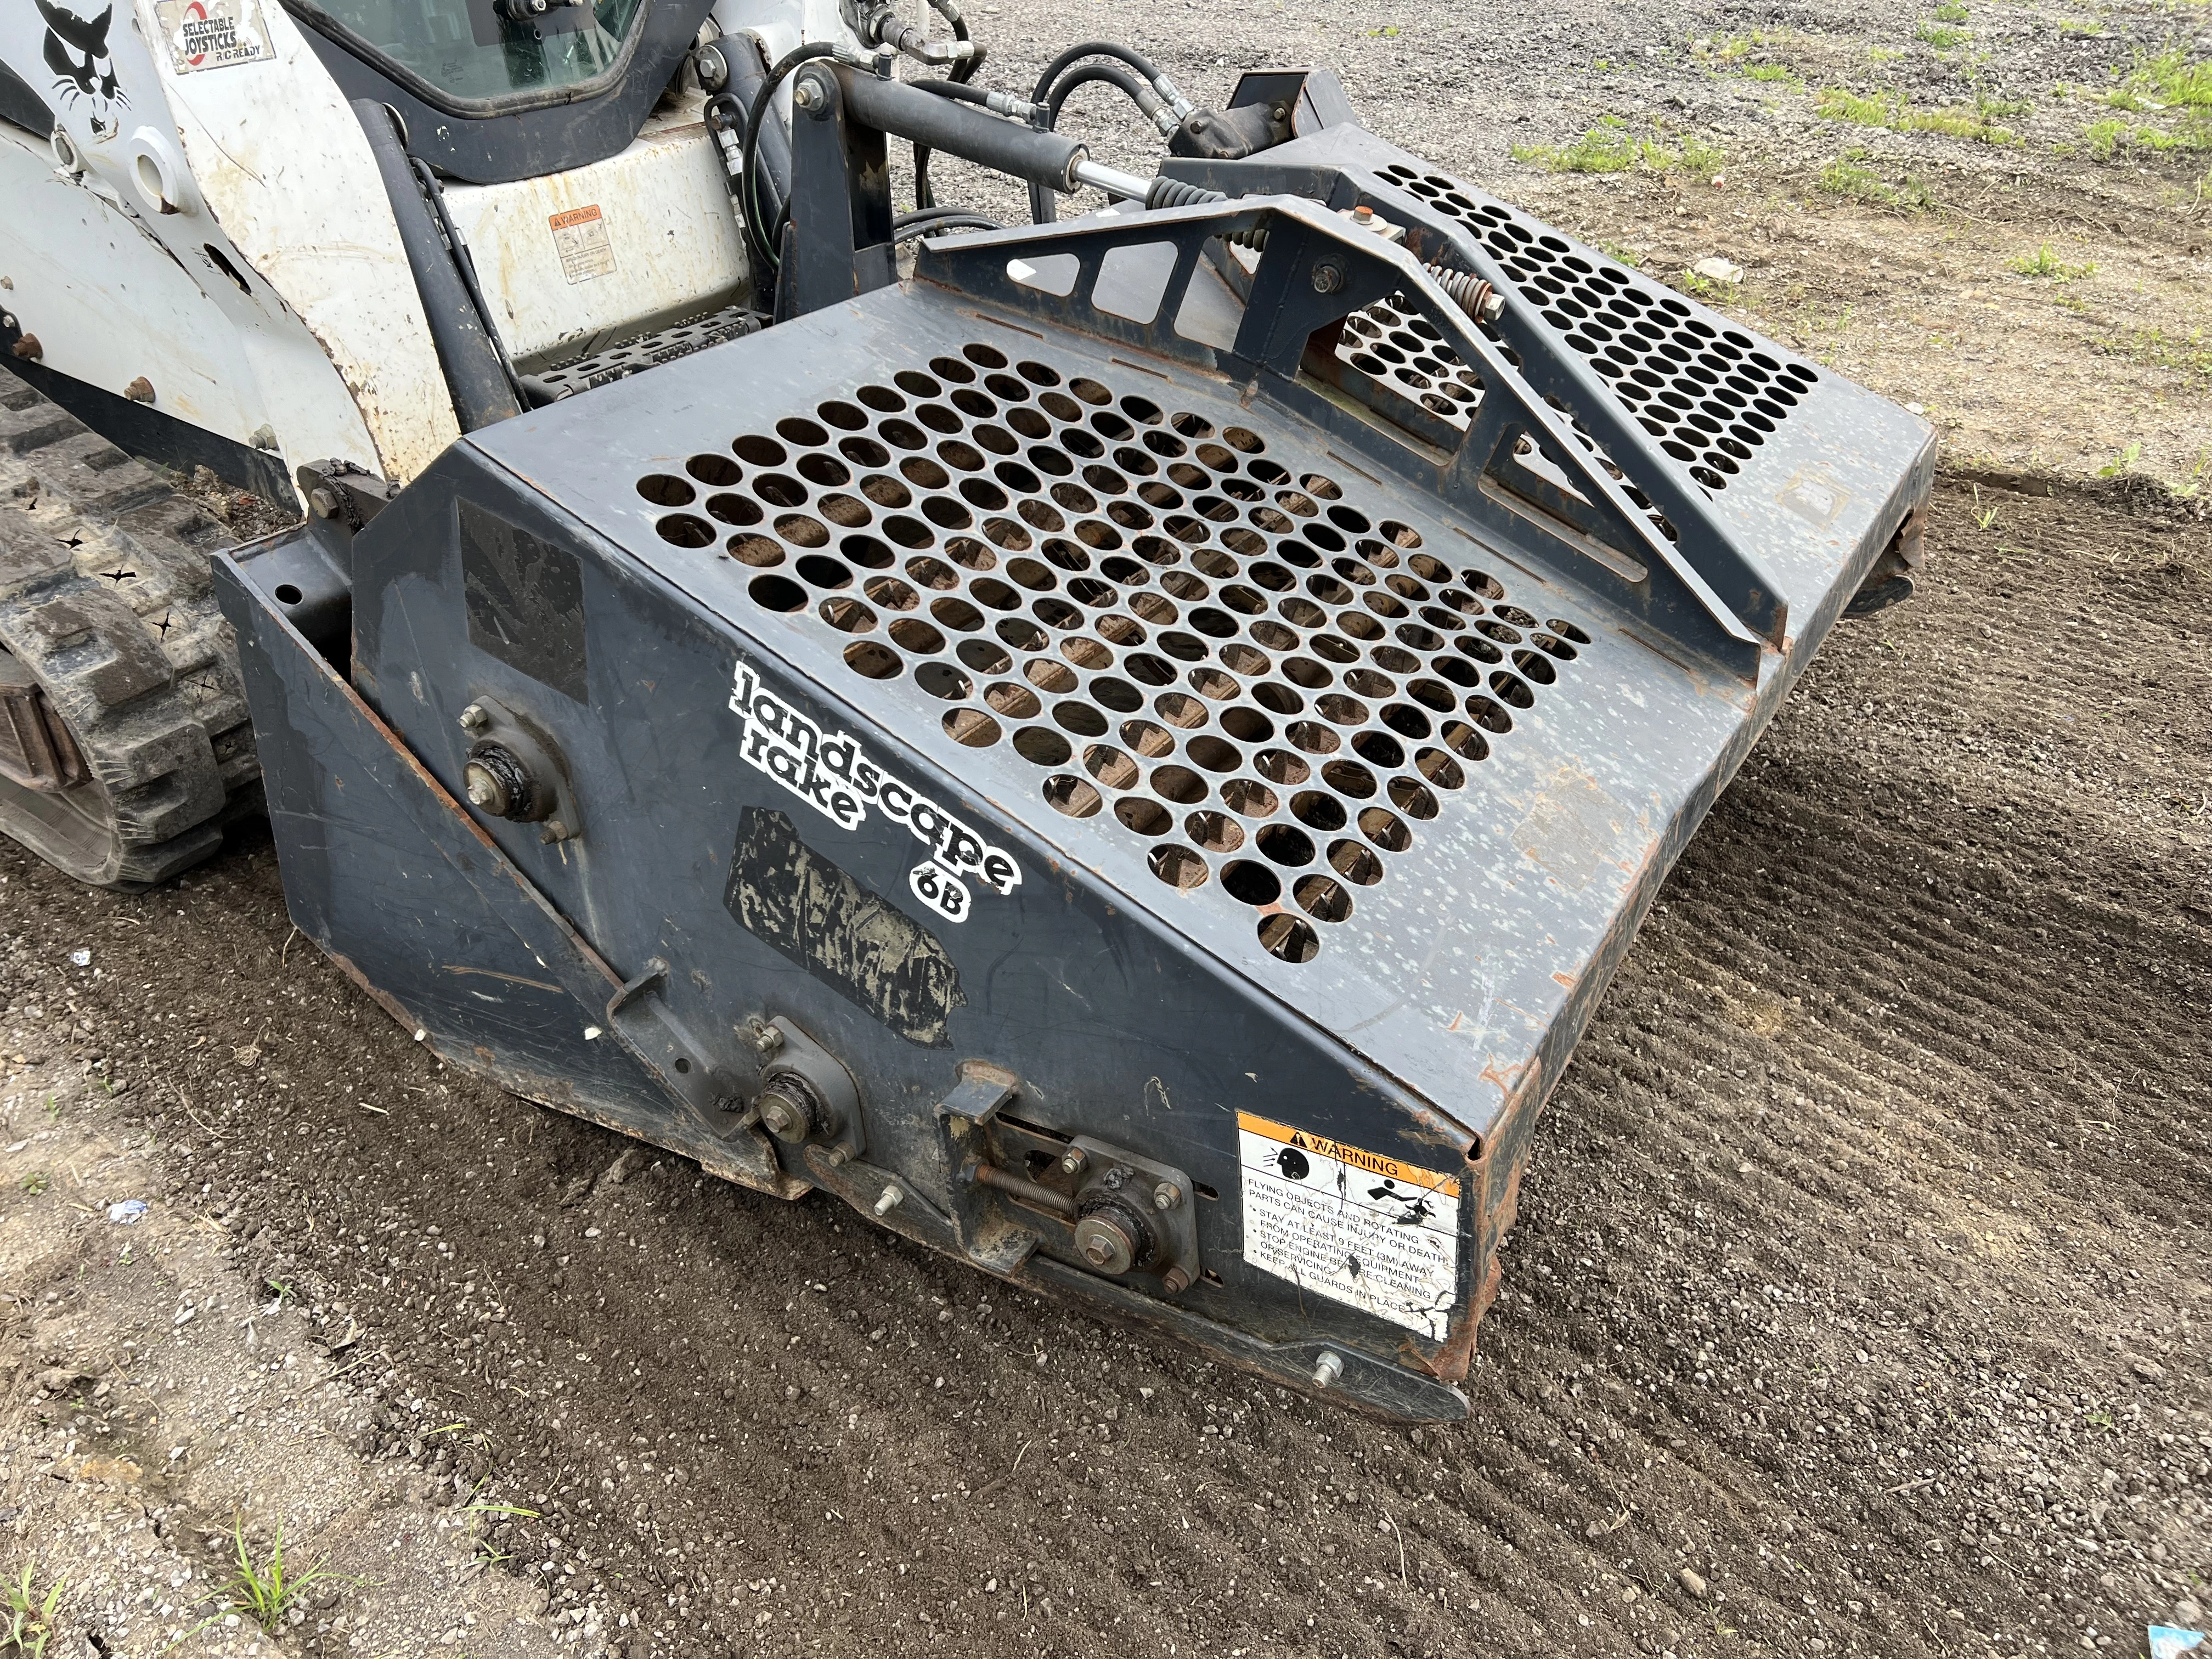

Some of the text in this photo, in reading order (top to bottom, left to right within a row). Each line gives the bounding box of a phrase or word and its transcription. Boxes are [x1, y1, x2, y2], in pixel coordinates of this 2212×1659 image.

[183, 16, 235, 37] SELECTABLE
[185, 31, 237, 55] JOYSTICKS
[233, 45, 261, 58] READY
[561, 208, 597, 224] WARNING
[732, 666, 1016, 890] landscape
[744, 725, 861, 826] rake
[911, 865, 965, 917] 6B
[1312, 1137, 1398, 1176] WARNING
[1248, 1178, 1419, 1244] FLYING OBJECTS AND ROTATING
[1249, 1189, 1281, 1206] PARTS
[1283, 1201, 1305, 1215] CAN
[1308, 1210, 1345, 1229] CAUSE
[1347, 1223, 1386, 1244] INJURY
[1389, 1239, 1406, 1251] OR
[1259, 1209, 1435, 1277] STAY AT LEAST 9 FEET (3M) AWAY
[1260, 1241, 1276, 1252] OR
[1260, 1220, 1289, 1237] FROM
[1356, 1255, 1419, 1284] EQUIPMENT
[1260, 1230, 1431, 1300] STOP ENGINE BERE CLEANING
[1260, 1250, 1285, 1265] KEEP
[1287, 1263, 1307, 1276] ALL
[1309, 1271, 1353, 1294] GUARDS
[1356, 1289, 1367, 1300] IN
